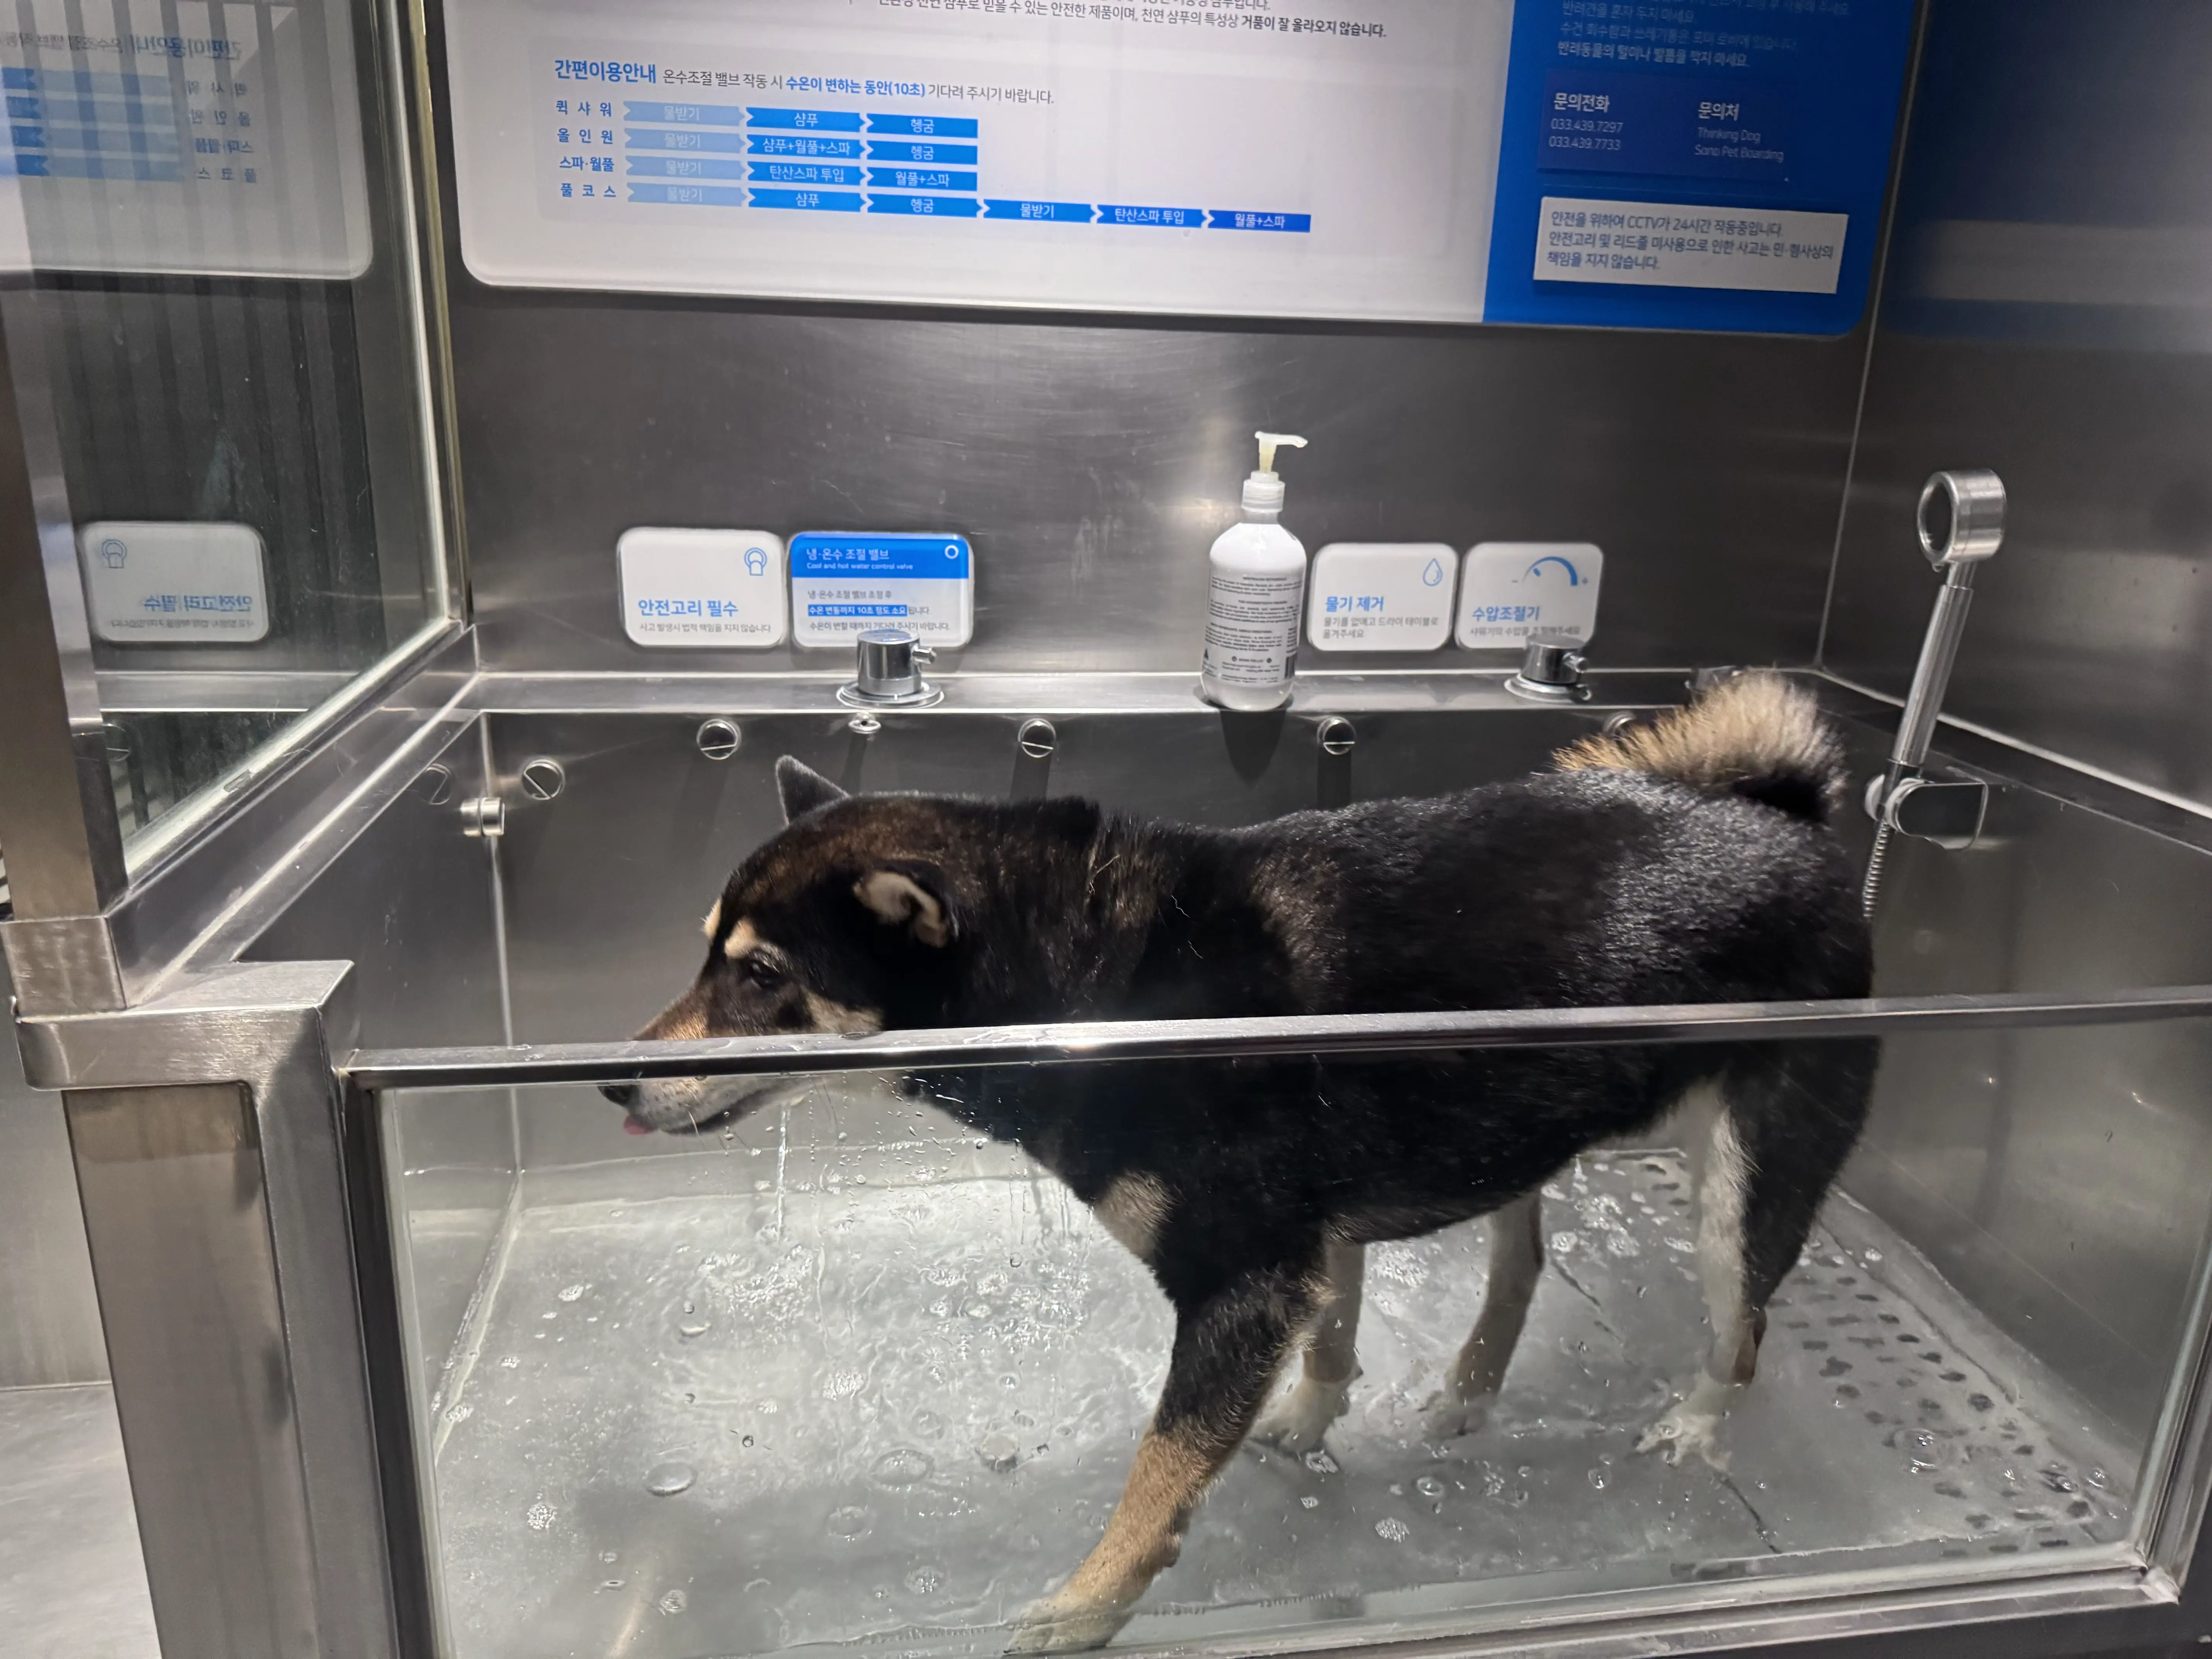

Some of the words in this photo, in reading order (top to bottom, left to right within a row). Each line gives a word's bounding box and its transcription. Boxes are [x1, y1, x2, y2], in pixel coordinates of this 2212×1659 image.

[983, 0, 1006, 14] 믿을
[1009, 2, 1022, 14] 수
[1025, 2, 1049, 16] 있는
[1051, 3, 1085, 18] 안전한
[1089, 5, 1139, 22] 제품이며,
[1141, 9, 1164, 23] 천연
[1167, 10, 1201, 25] 샴푸의
[1204, 12, 1239, 28] 특성상
[1241, 14, 1275, 31] 거품이
[1278, 18, 1289, 31] 잘
[1292, 19, 1337, 35] 올라오지
[1339, 22, 1387, 38] 않습니다.
[555, 59, 656, 83] 간편이용안내
[663, 69, 713, 86] 온수조절
[715, 71, 740, 87] 밸브
[742, 74, 767, 89] 작동
[771, 76, 782, 89] 시
[785, 76, 822, 93] 수온이
[825, 77, 861, 95] 변하는
[864, 80, 926, 98] 동안(10초)
[928, 84, 964, 100] 기다려
[967, 86, 1002, 101] 주시기
[1005, 89, 1054, 104] 바랍니다.
[1554, 92, 1610, 113] 문의전화
[664, 105, 699, 121] 물받기
[1698, 101, 1740, 121] 문의처
[794, 112, 818, 127] 샴푸
[910, 118, 934, 134] 헹굼
[1551, 118, 1624, 134] 033.439.7297
[664, 132, 700, 149] 물받기
[1740, 129, 1761, 144] Dog
[763, 138, 850, 156] 샴푸+월풀+스파
[911, 145, 934, 160] 헹굼
[666, 160, 701, 175] 물받기
[769, 165, 817, 181] 탄산스파
[821, 168, 844, 182] 투입
[895, 171, 950, 187] 월풀+스파
[667, 186, 702, 203] 물받기
[795, 192, 820, 207] 샴푸
[910, 198, 934, 213] 헹굼
[1020, 203, 1055, 219] 물받기
[1115, 208, 1159, 223] 탄산스파
[1162, 210, 1185, 225] 투입
[1234, 213, 1286, 229] 월풀+스파
[1551, 211, 1587, 228] 안전을
[1590, 213, 1625, 229] 위하여
[1627, 215, 1671, 231] CCTV가
[1672, 218, 1711, 234] 24시간
[1549, 231, 1596, 248] 안전고리
[1599, 233, 1611, 248] 및
[1613, 234, 1648, 251] 리드줄
[1651, 235, 1708, 252] 미사용으로
[1712, 239, 1735, 255] 인한
[1737, 241, 1771, 256] 사고는
[1547, 252, 1582, 267] 책임을
[1585, 253, 1609, 269] 지지
[1611, 253, 1660, 270] 않습니다.
[806, 548, 843, 561] 냉·온수
[845, 548, 866, 561] 조절
[868, 548, 890, 561] 밸브
[638, 599, 702, 617] 안전고리
[707, 600, 739, 617] 필수
[1325, 596, 1353, 612] 물기
[1357, 596, 1384, 612] 제거
[1472, 606, 1540, 622] 수압조절기
